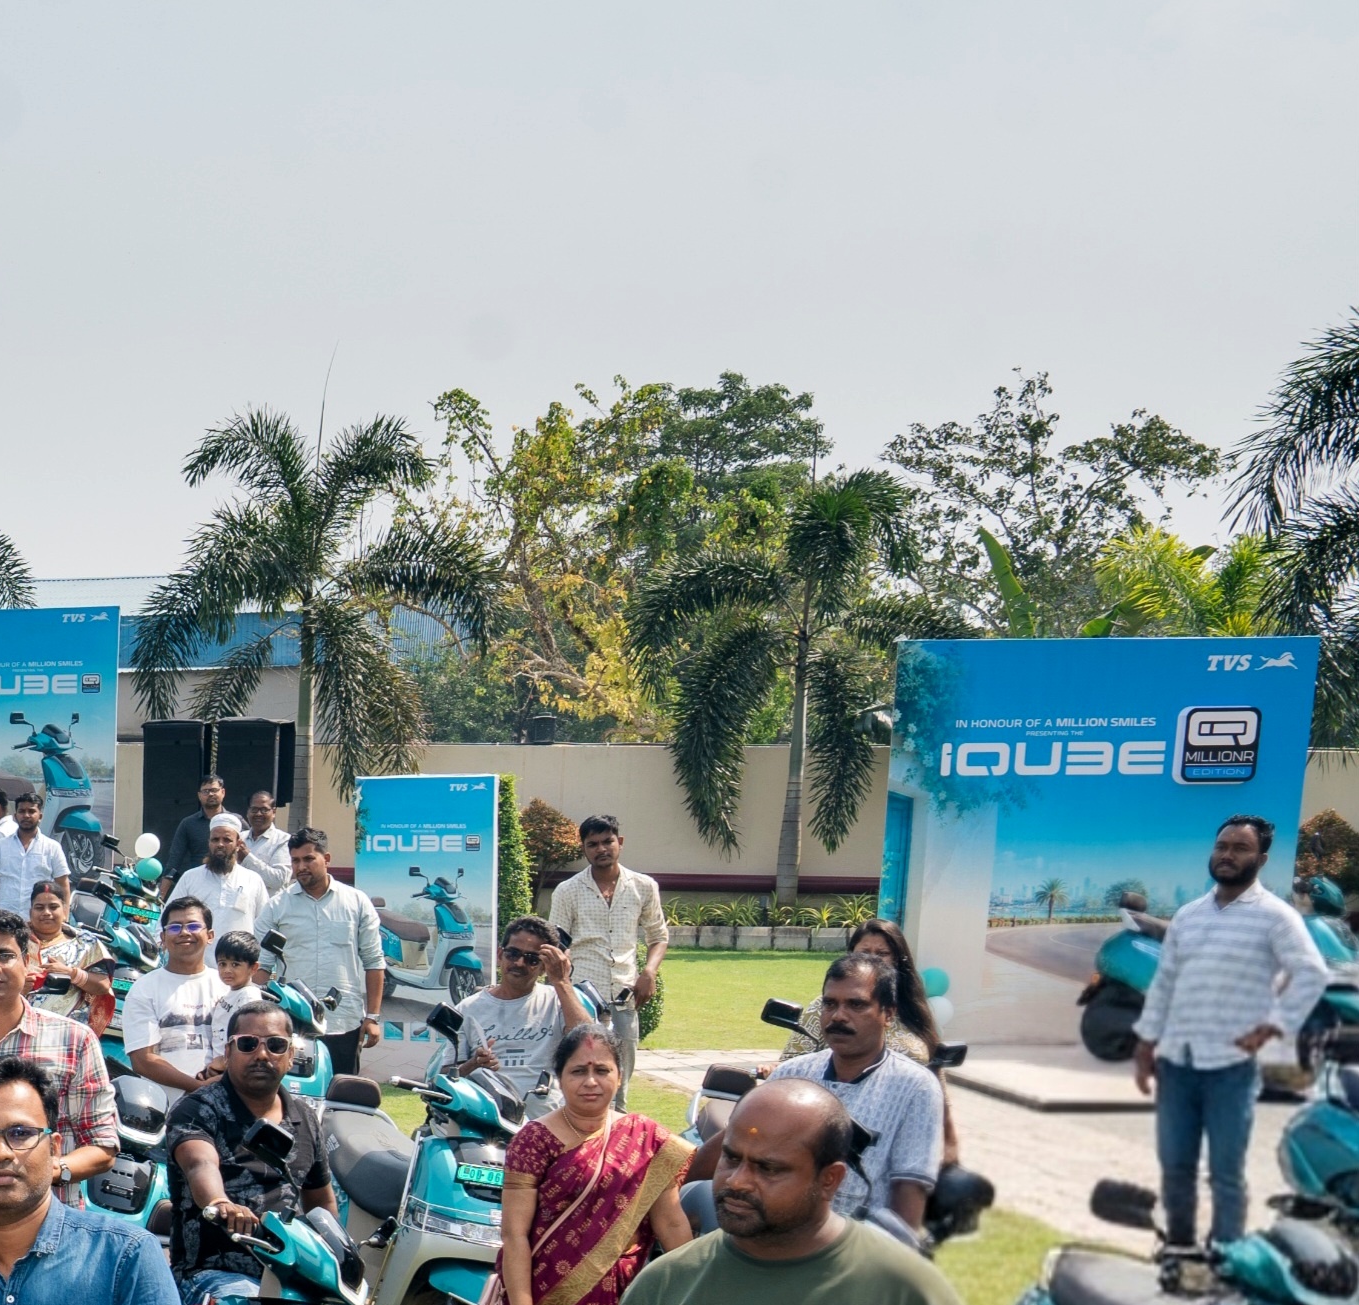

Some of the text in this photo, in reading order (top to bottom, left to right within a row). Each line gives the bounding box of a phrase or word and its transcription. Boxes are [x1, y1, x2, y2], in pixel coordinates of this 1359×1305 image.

[62, 614, 85, 623] TVS
[1208, 654, 1252, 671] TVS
[955, 718, 1156, 728] IN HONOUR OF A MILLION SMILES
[1185, 751, 1254, 762] MILLIONR
